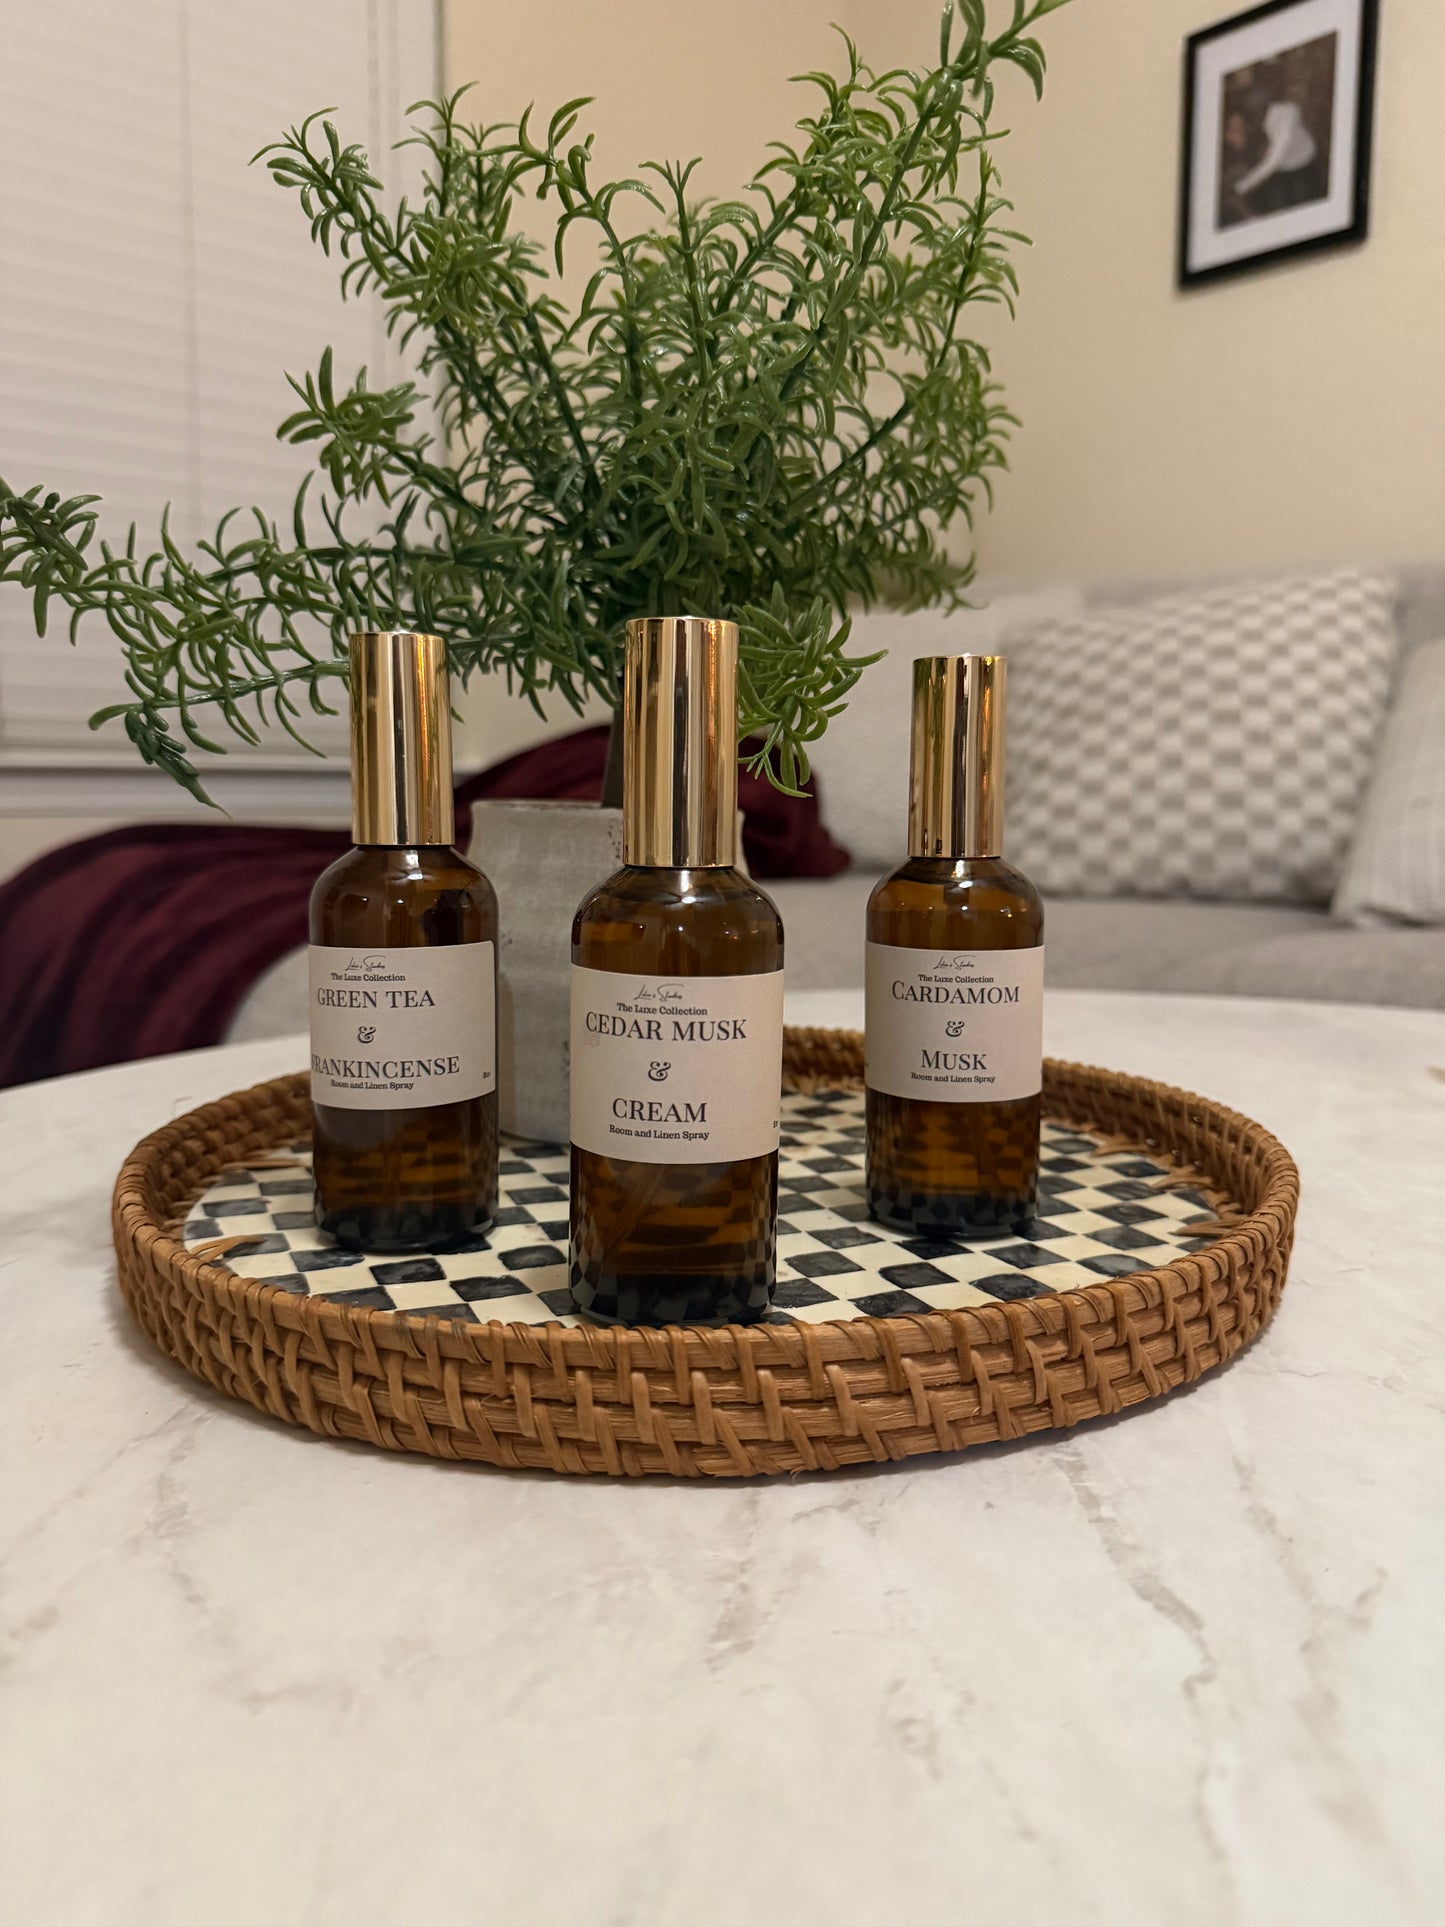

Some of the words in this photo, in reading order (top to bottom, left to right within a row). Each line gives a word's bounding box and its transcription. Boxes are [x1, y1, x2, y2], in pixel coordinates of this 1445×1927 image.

[331, 973, 343, 981] The
[344, 973, 362, 981] Luxe
[918, 974, 932, 982] The
[318, 988, 377, 1008] GREEN
[386, 990, 435, 1008] TEA
[892, 980, 1019, 1004] CARDAMOM
[617, 1002, 632, 1012] The
[635, 1004, 656, 1014] Luxe
[659, 1005, 707, 1015] Collection
[358, 1026, 376, 1043] &
[586, 1012, 663, 1040] CEDAR
[672, 1019, 746, 1041] MUSK
[945, 1021, 964, 1037] &
[921, 1050, 986, 1070] MUSK
[648, 1061, 671, 1081] &
[911, 1072, 932, 1081] Room
[974, 1075, 995, 1083] Spray
[331, 1080, 349, 1088] Room
[390, 1082, 414, 1090] Spray
[613, 1098, 707, 1123] CREAM
[609, 1125, 633, 1136] Room
[635, 1129, 651, 1138] and
[654, 1130, 680, 1139] Linen
[683, 1131, 710, 1140] Spray
